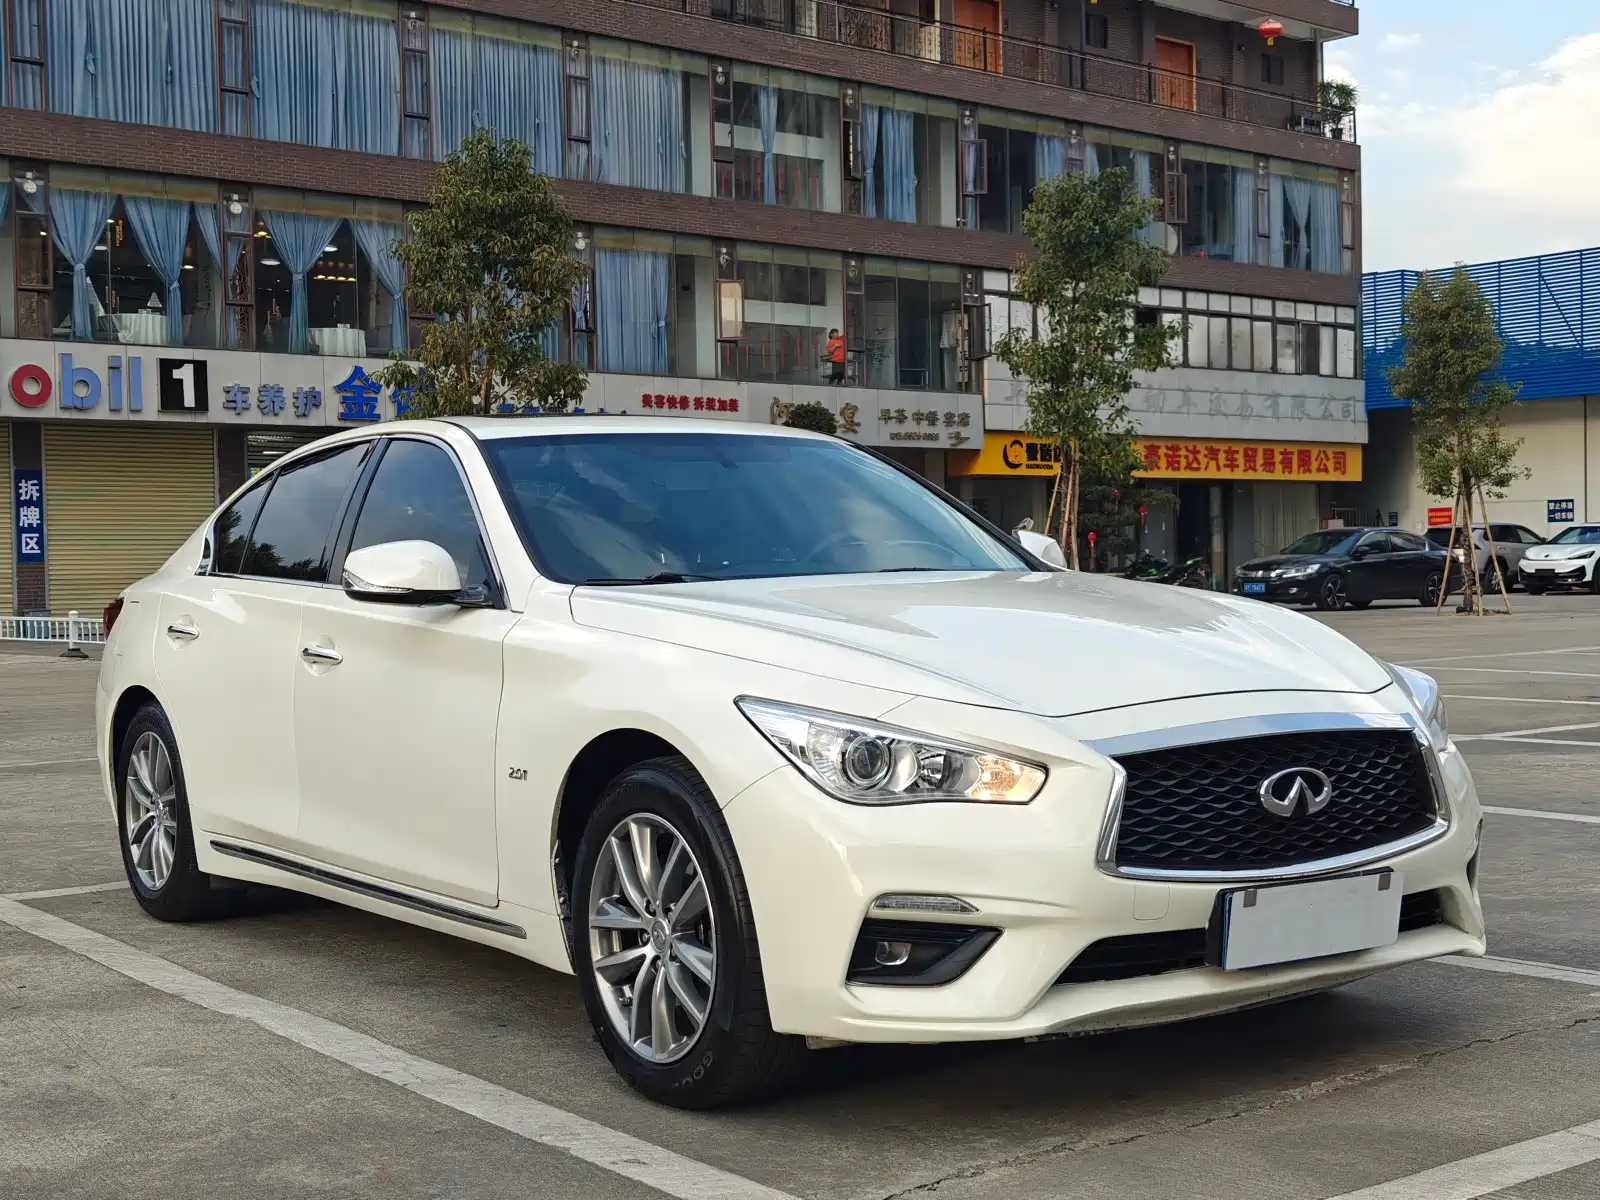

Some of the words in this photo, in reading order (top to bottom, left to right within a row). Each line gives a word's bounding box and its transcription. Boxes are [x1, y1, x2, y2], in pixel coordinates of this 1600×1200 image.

[171, 362, 196, 409] 1
[222, 382, 323, 418] 车养护
[878, 408, 908, 424] 早茶
[1142, 443, 1348, 475] 豪诺达汽车贸易有限公司
[18, 478, 41, 555] 拆牌区
